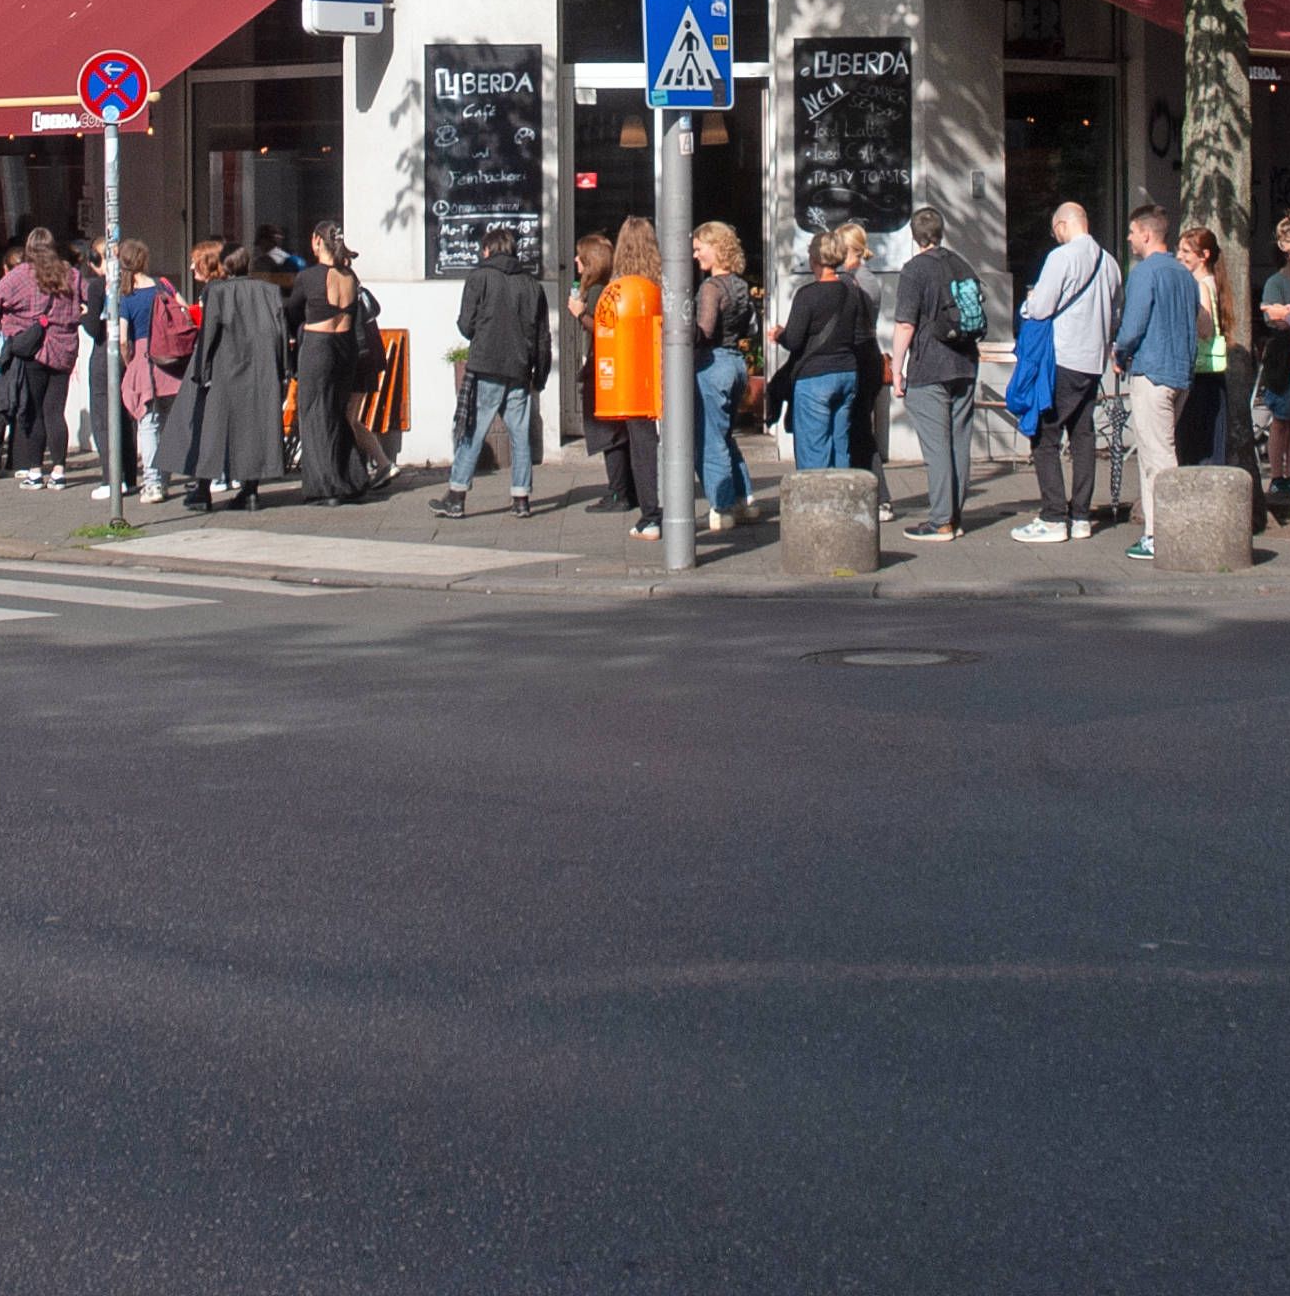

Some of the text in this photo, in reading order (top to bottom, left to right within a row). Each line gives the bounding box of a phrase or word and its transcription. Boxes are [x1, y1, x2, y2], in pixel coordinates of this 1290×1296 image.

[802, 82, 844, 116] NEU
[812, 169, 910, 185] TASTY TOASTS
